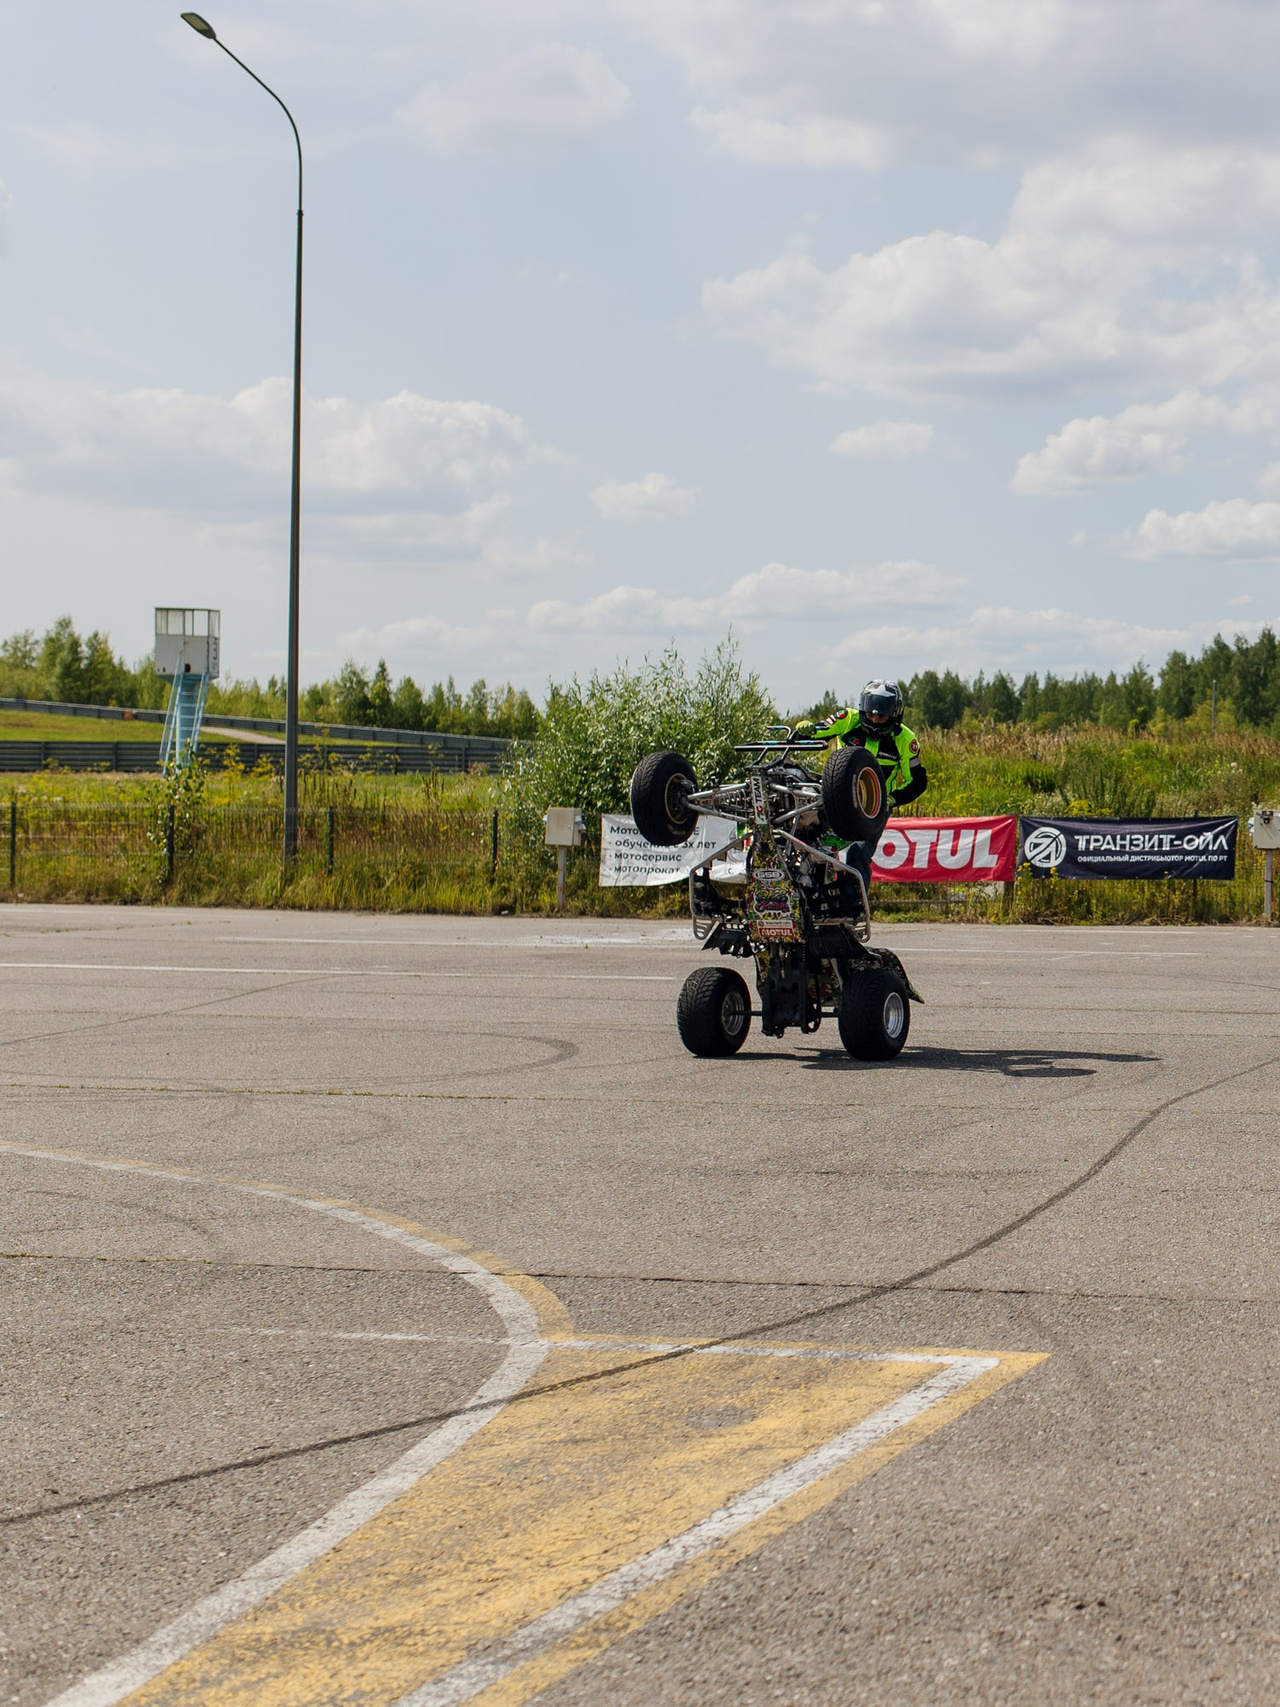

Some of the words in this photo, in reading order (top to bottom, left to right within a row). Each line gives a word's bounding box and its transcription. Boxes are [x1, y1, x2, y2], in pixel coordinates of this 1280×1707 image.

[753, 777, 763, 803] TEAM
[697, 841, 717, 849] лет
[1074, 832, 1229, 851] ТРАНЗИТ-ОЙЛ
[872, 829, 999, 869] OTUL
[615, 852, 682, 862] мотосервис
[1077, 855, 1129, 863] ОФИЦИАЛЬНЫЙ
[614, 866, 680, 875] мотопрокат
